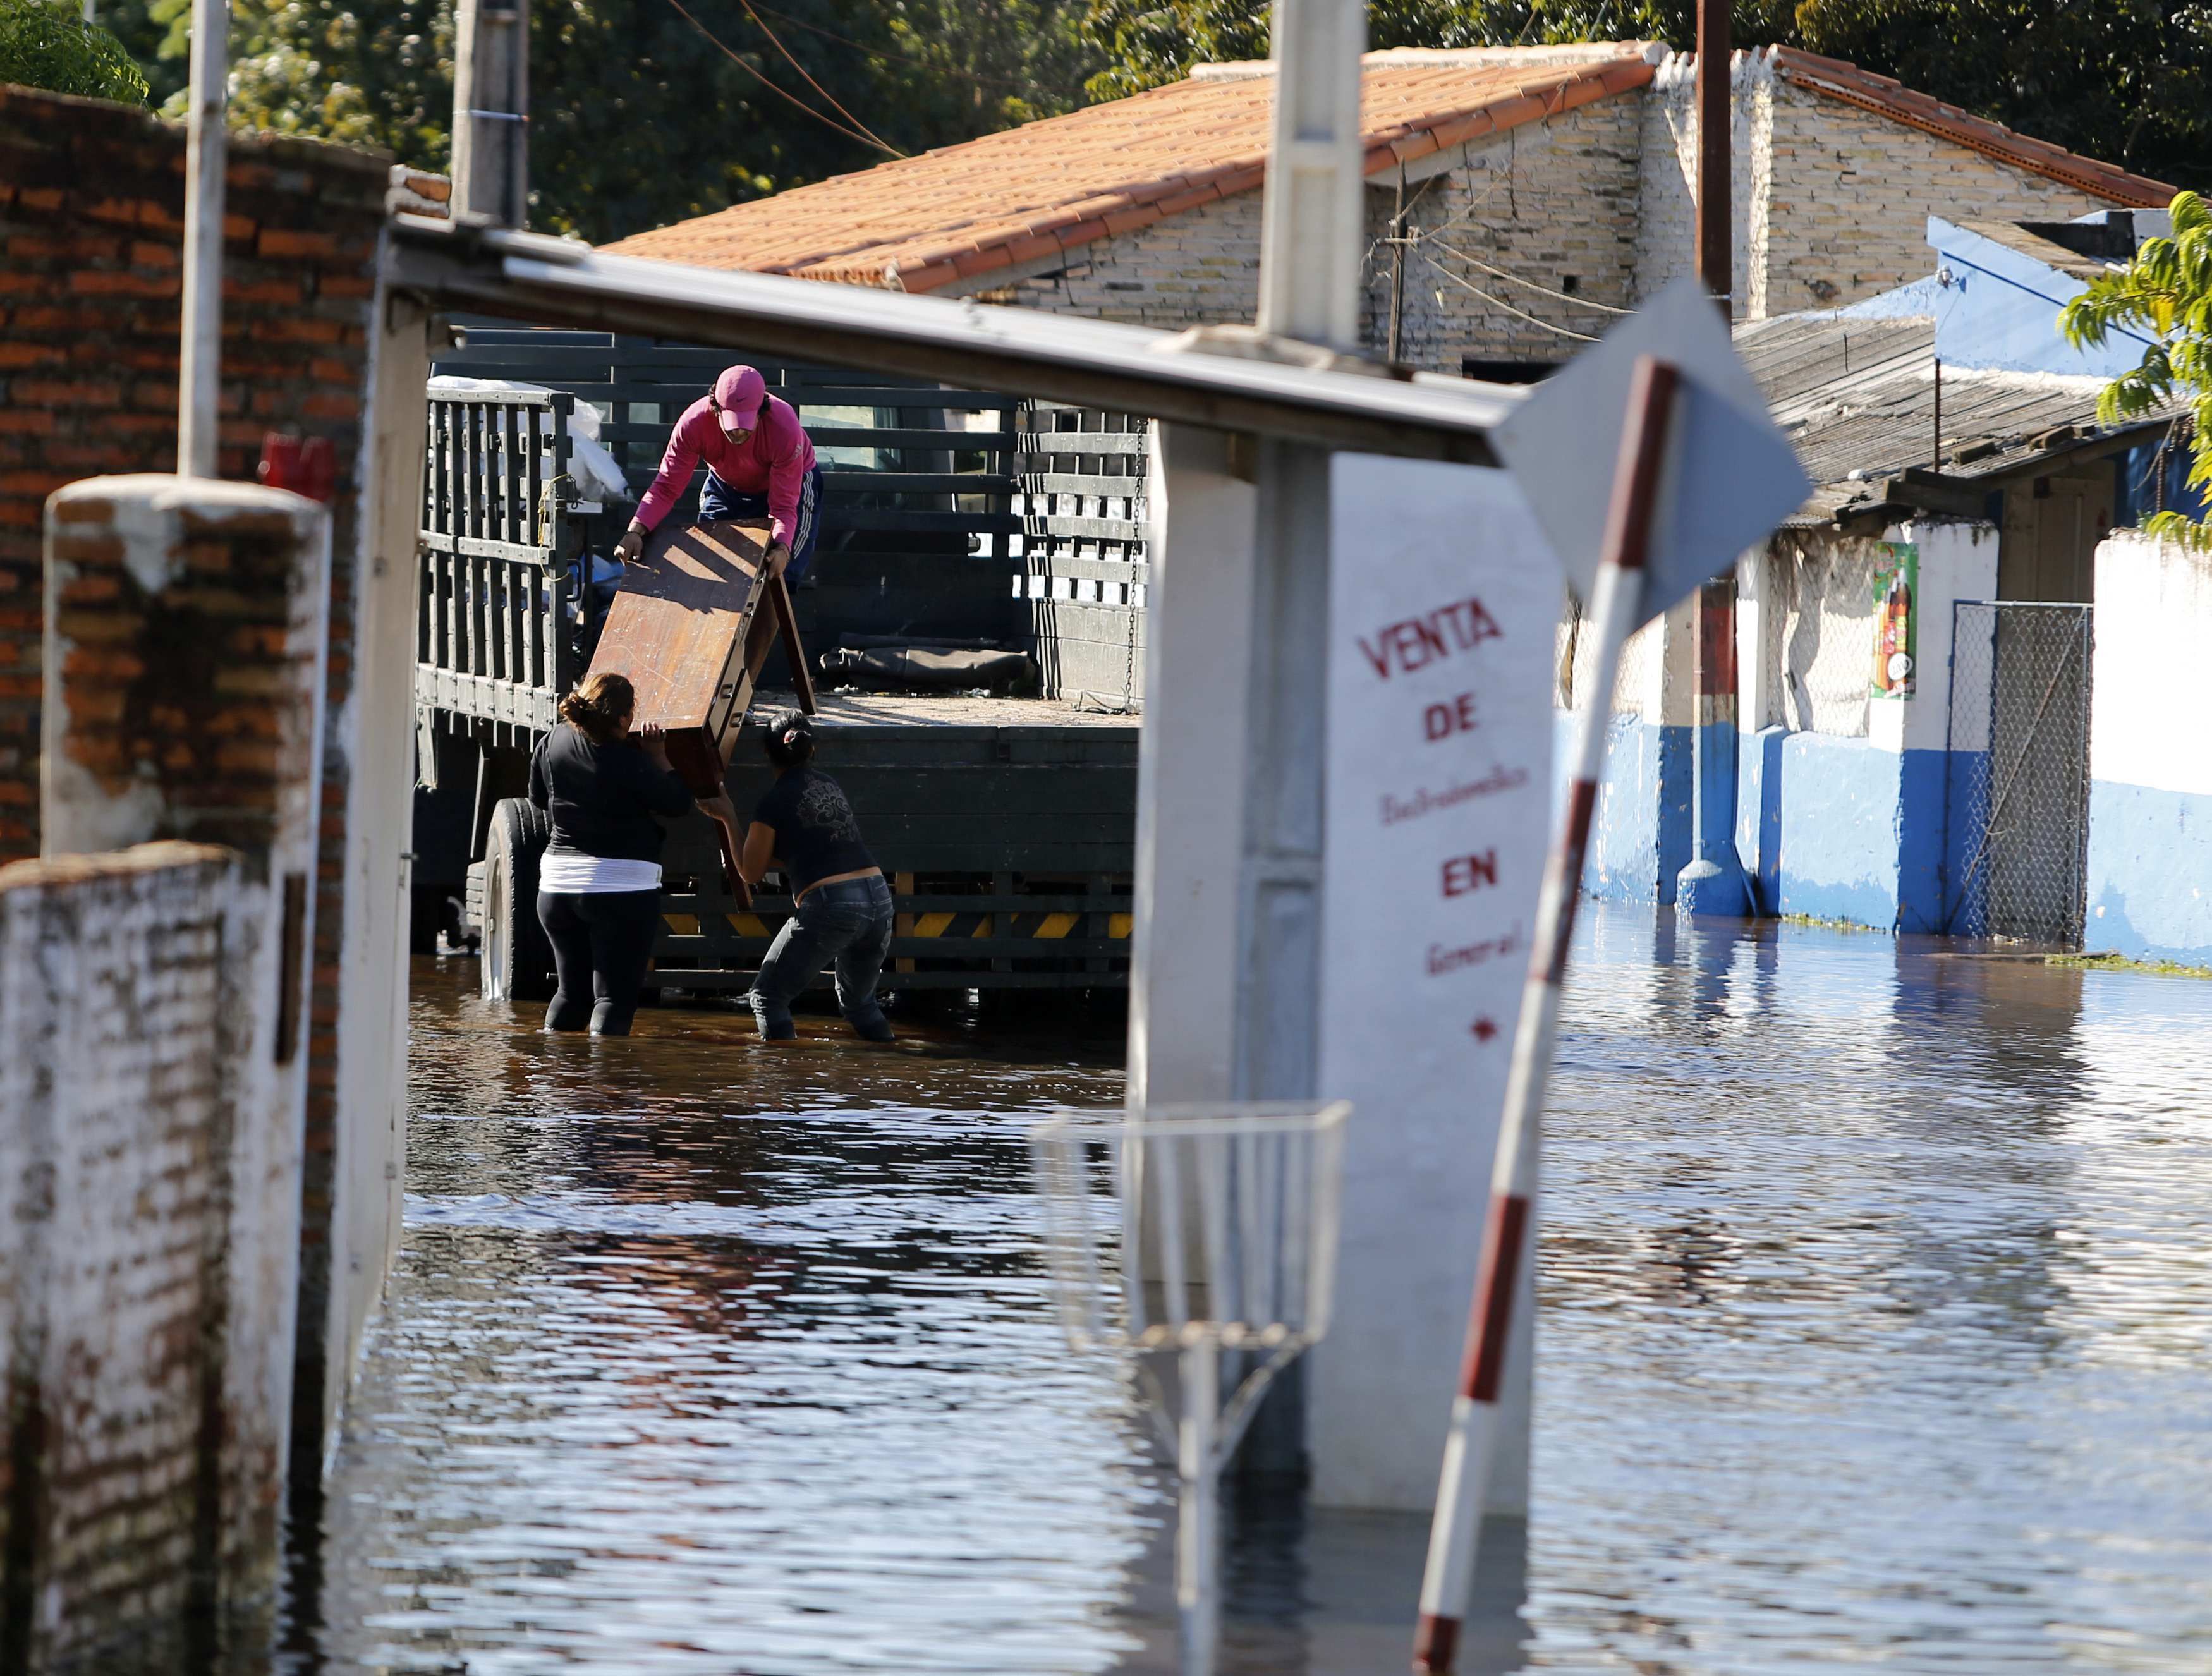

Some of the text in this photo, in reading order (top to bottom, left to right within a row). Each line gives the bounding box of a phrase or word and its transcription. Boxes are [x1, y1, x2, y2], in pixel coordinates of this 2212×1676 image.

[1358, 596, 1504, 681] VENTA
[1424, 693, 1478, 742] DE
[1442, 848, 1498, 898] EN
